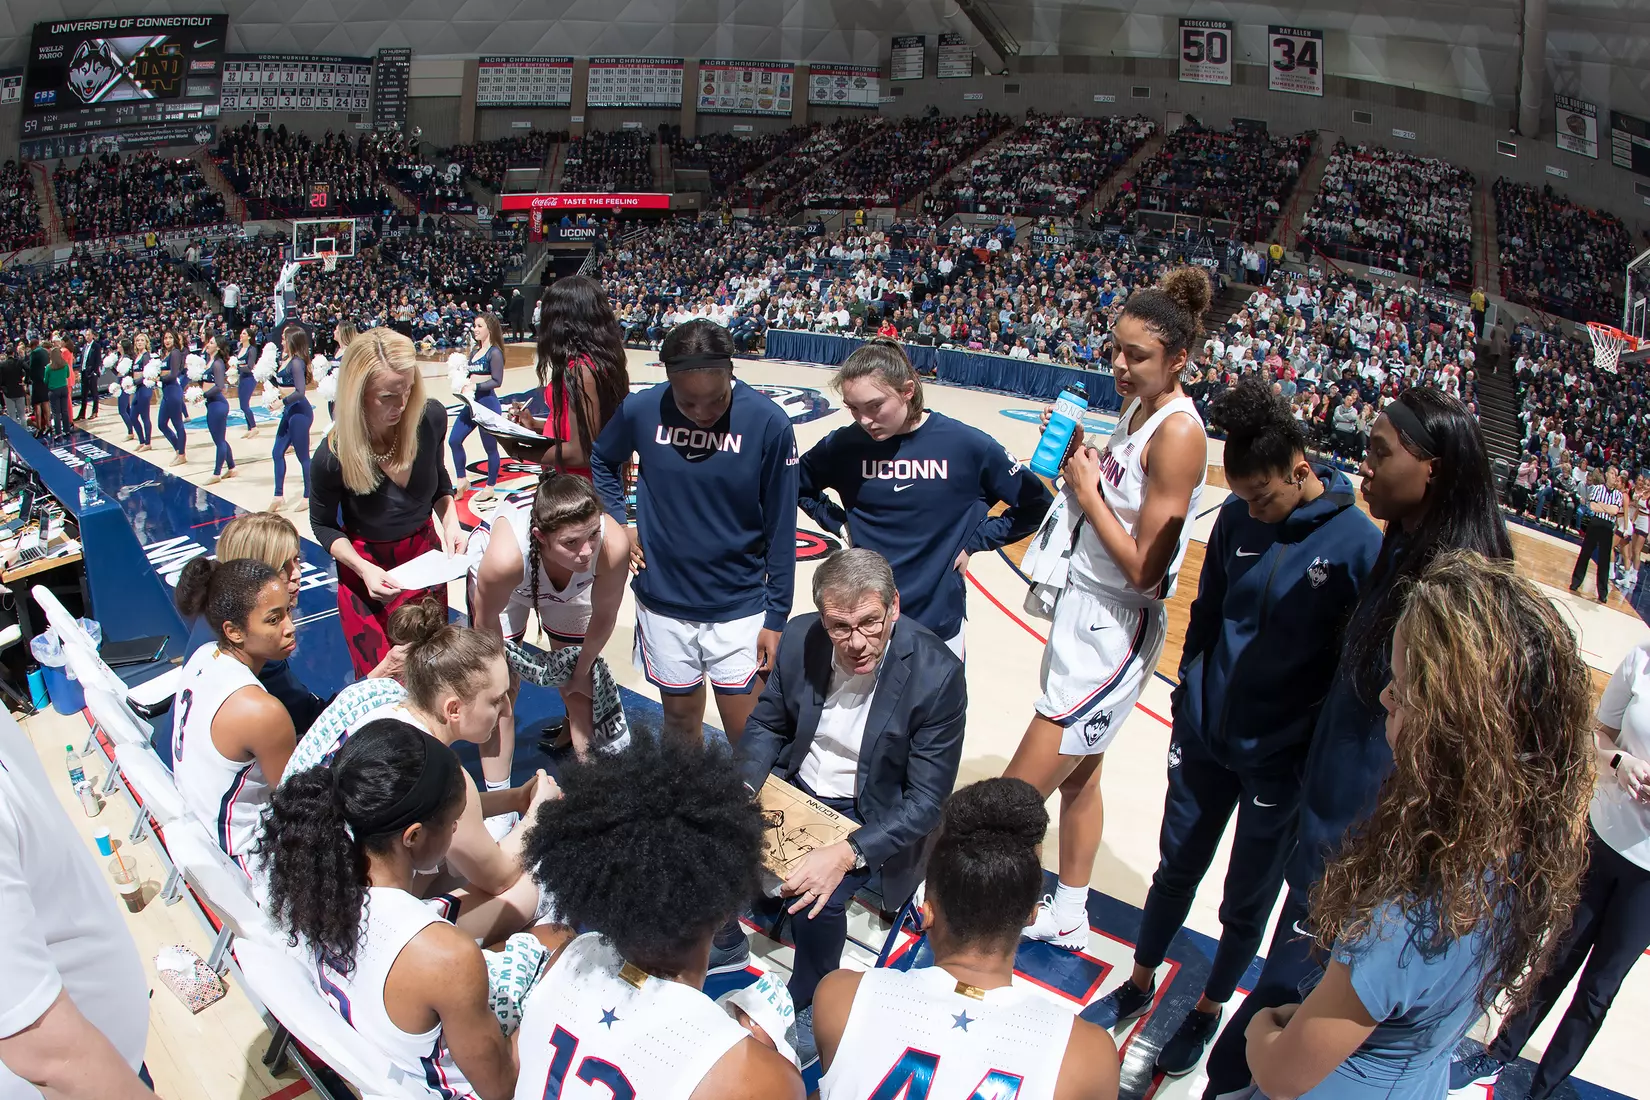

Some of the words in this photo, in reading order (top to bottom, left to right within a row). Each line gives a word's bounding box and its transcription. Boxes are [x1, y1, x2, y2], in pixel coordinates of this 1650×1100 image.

[51, 20, 118, 34] UNIVERSITY
[120, 19, 134, 28] OF
[136, 17, 212, 27] CONNECTICUT
[1184, 30, 1227, 64] 50
[1273, 38, 1318, 75] 34
[228, 72, 236, 81] 32
[249, 72, 254, 81] 3
[305, 73, 312, 82] 31
[322, 74, 330, 82] 23
[340, 75, 348, 83] 31
[359, 75, 366, 83] 14
[34, 90, 55, 99] CBS
[224, 98, 235, 106] 23
[246, 97, 252, 106] 4
[263, 97, 274, 106] 30
[284, 97, 290, 106] 3
[321, 98, 328, 106] 15
[336, 99, 349, 107] 24
[116, 106, 134, 115] 4:47
[24, 120, 38, 132] 59
[311, 193, 327, 207] 20
[560, 229, 596, 237] UCONN
[1202, 258, 1219, 267] 109
[655, 426, 743, 454] UCONN
[862, 459, 948, 480] UCONN
[806, 800, 840, 820] UCONN
